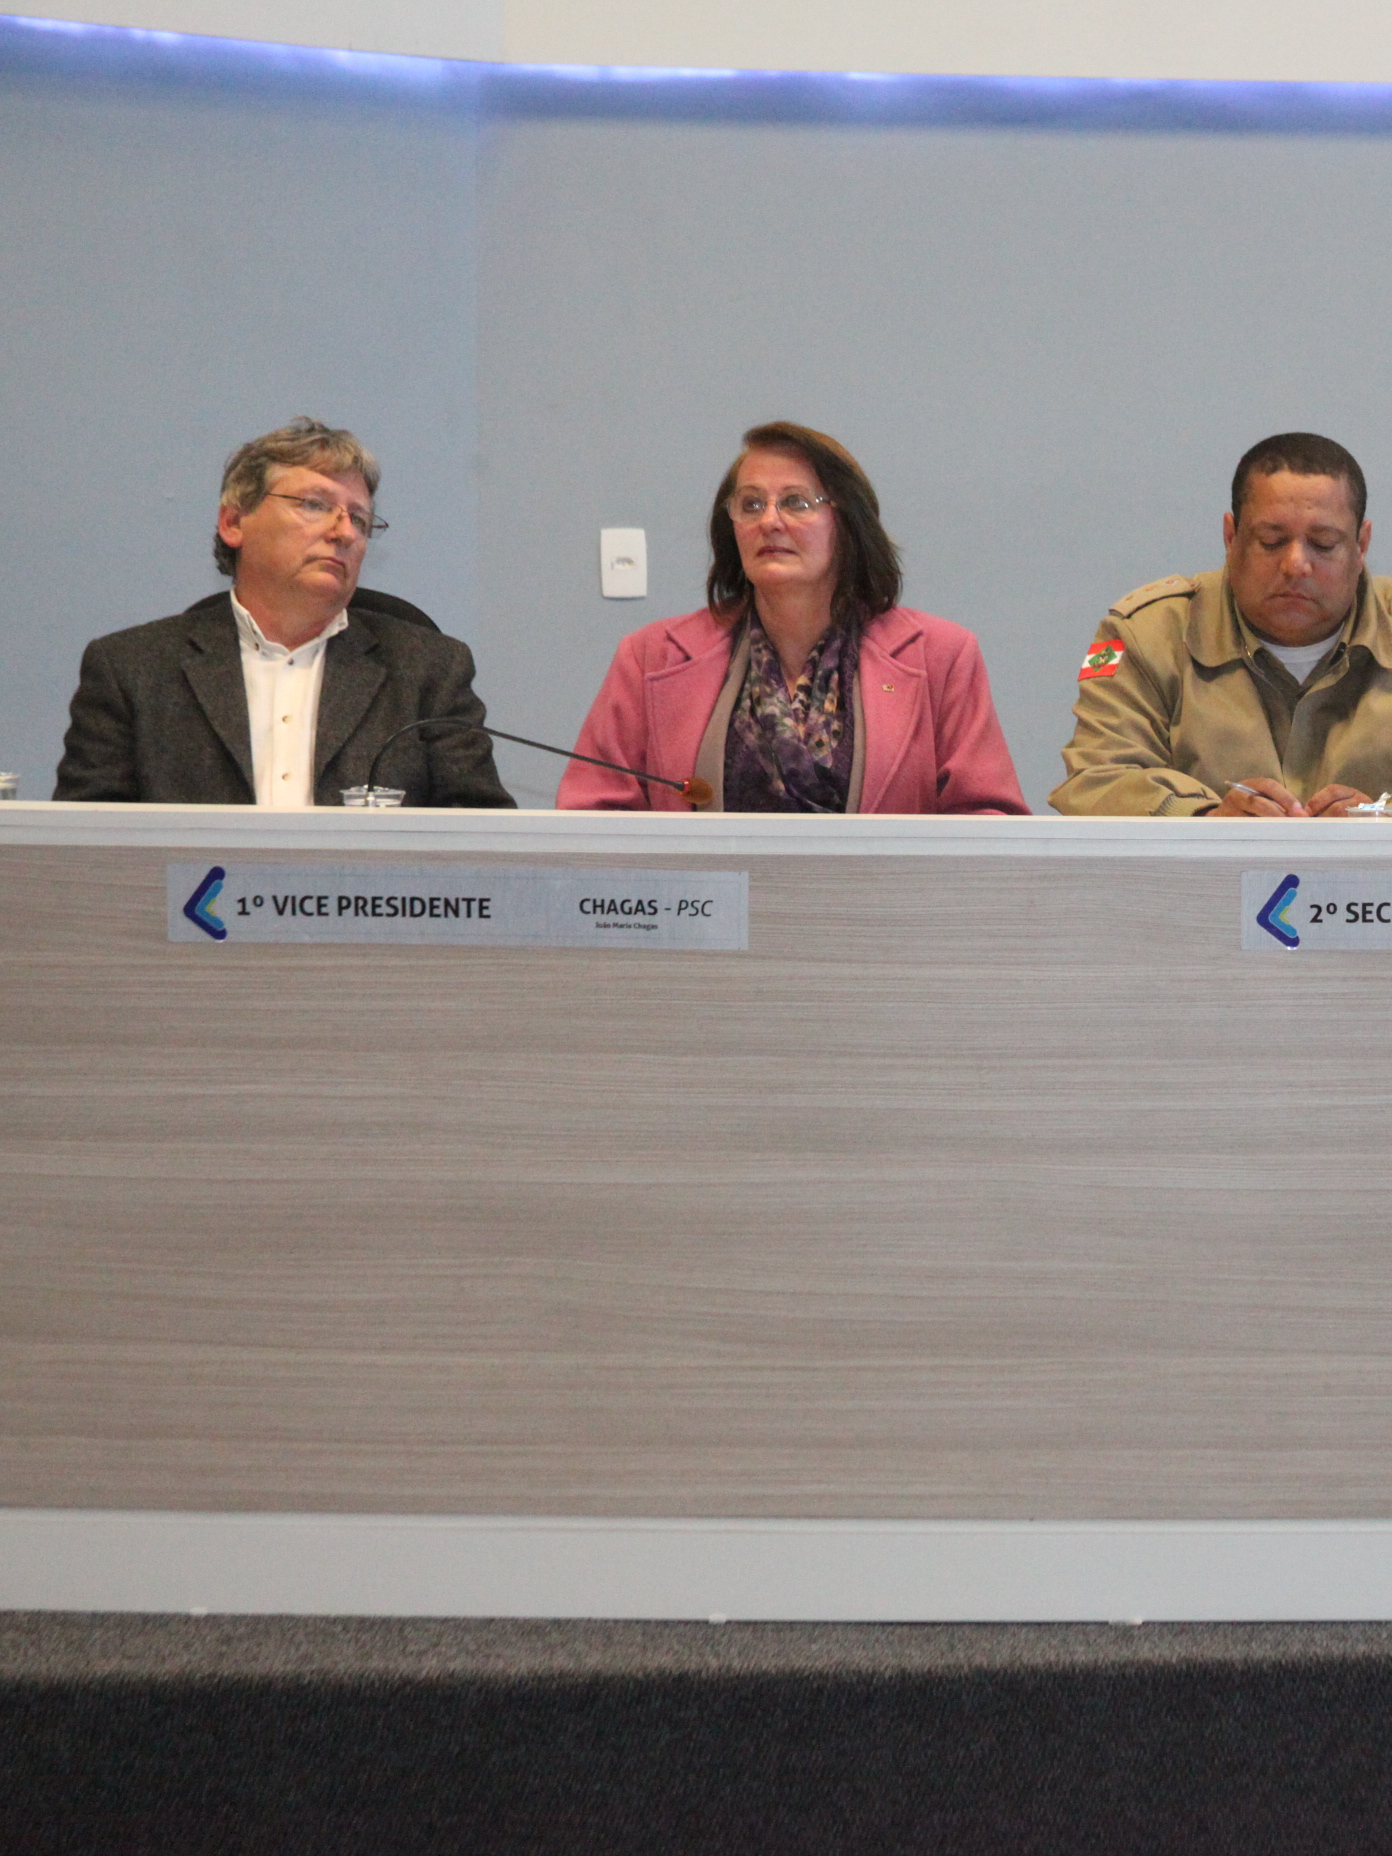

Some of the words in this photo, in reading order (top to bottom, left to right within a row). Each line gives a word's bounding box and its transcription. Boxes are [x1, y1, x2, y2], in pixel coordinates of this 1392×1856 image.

[271, 894, 330, 917] VICE
[337, 895, 492, 919] PRESIDENTE
[578, 897, 659, 916] CHAGAS
[676, 899, 714, 917] PSC
[633, 922, 659, 932] Chagas
